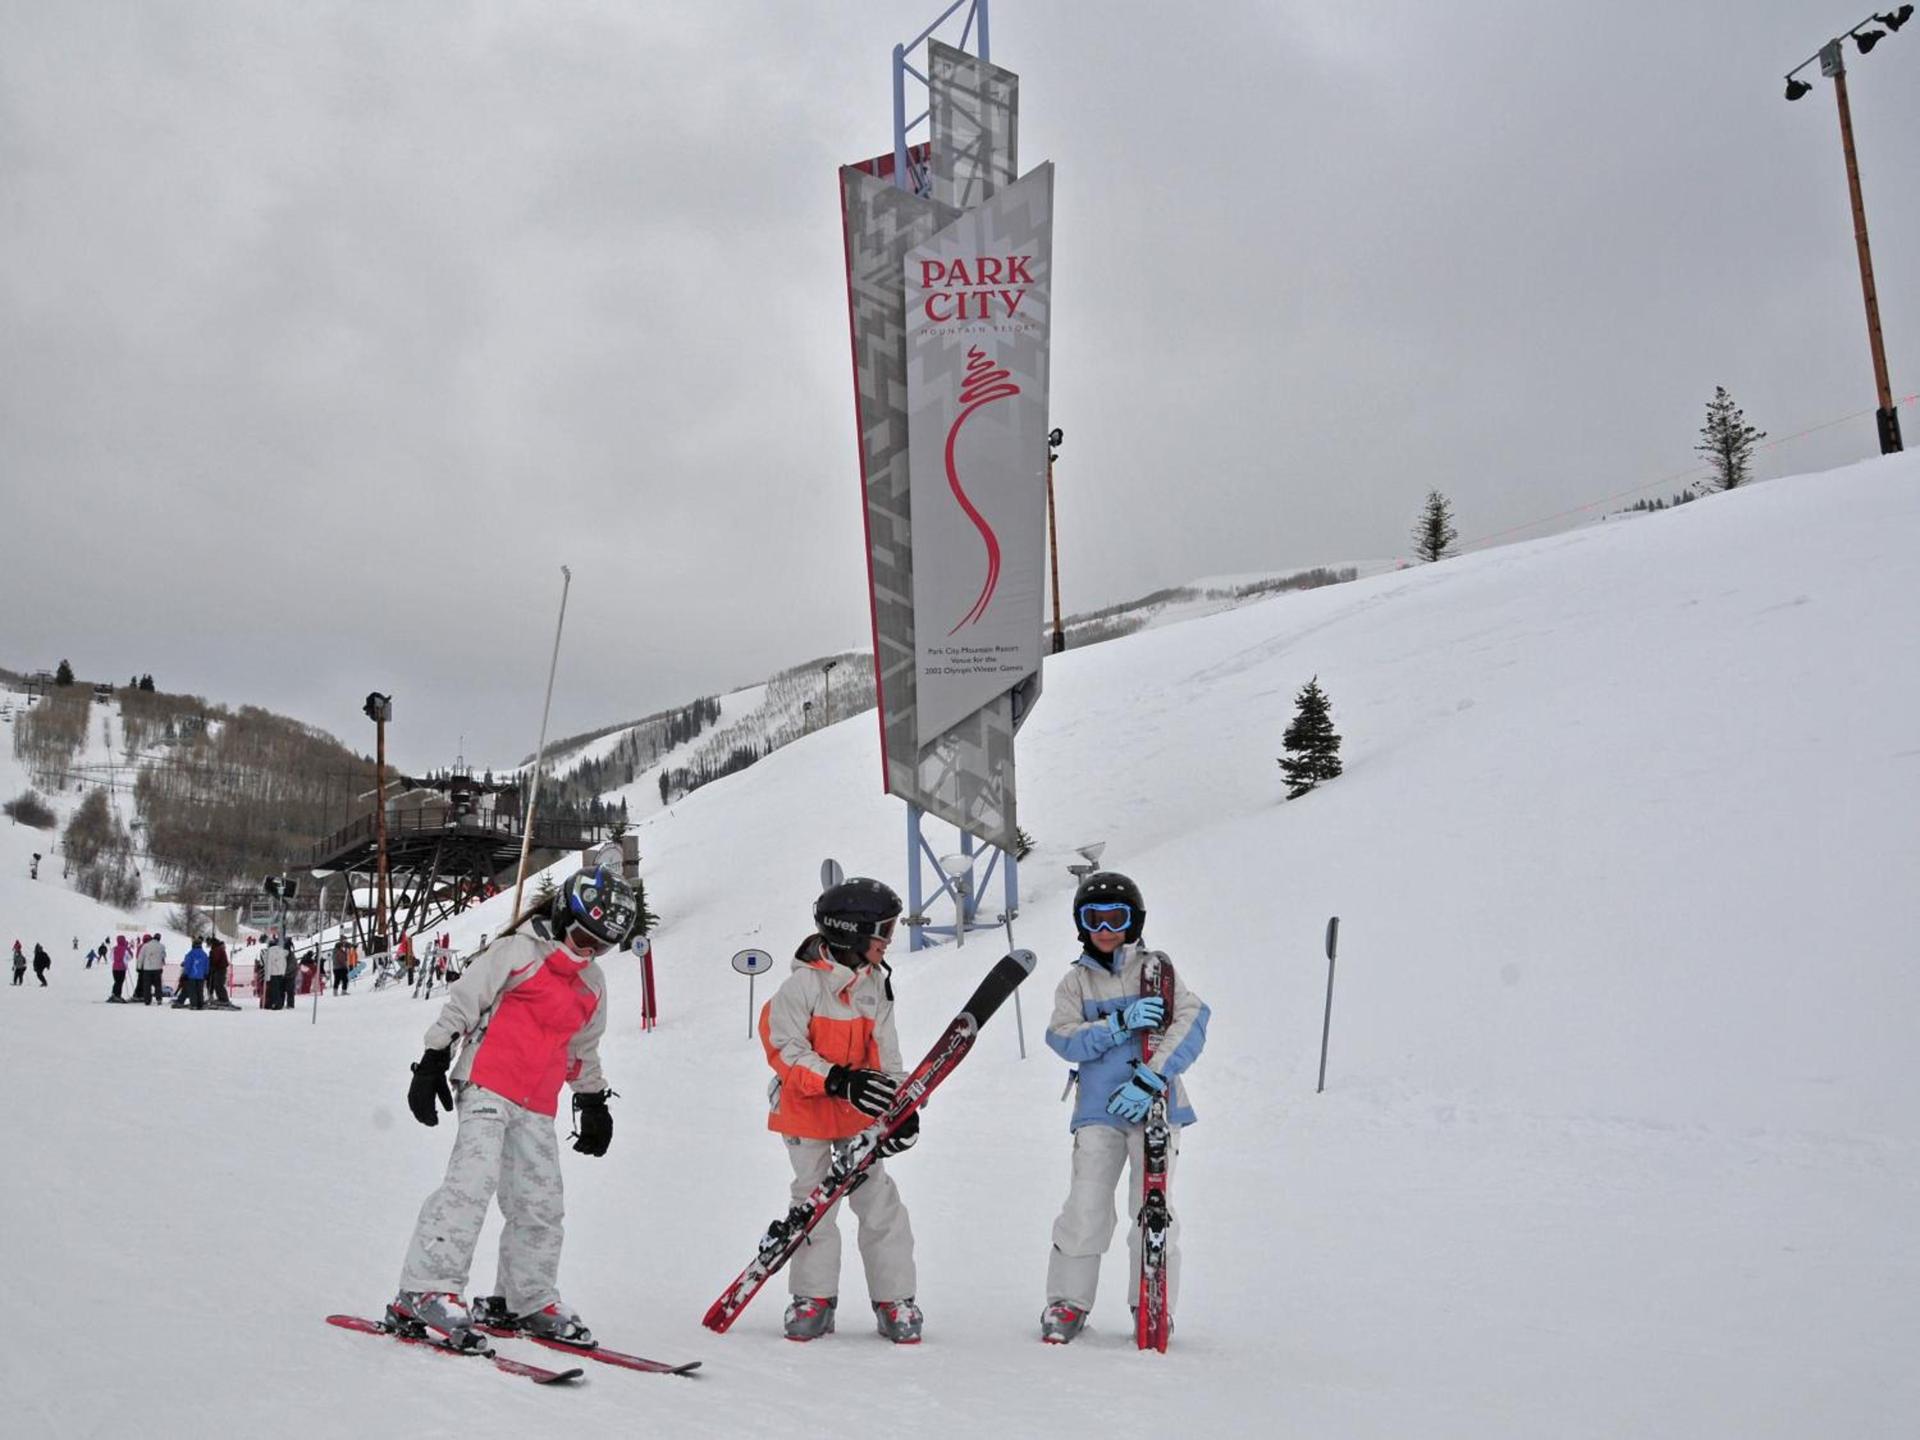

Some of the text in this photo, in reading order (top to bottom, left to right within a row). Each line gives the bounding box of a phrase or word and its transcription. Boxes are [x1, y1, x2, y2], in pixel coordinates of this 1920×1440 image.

[920, 256, 1034, 288] PARK
[925, 289, 1026, 322] CITY
[921, 323, 1037, 337] MOUNTAIN RESORT
[928, 647, 943, 655] Park
[945, 647, 960, 656] City
[961, 646, 993, 654] Mountain
[1000, 664, 1023, 672] Games
[823, 916, 858, 933] uvex
